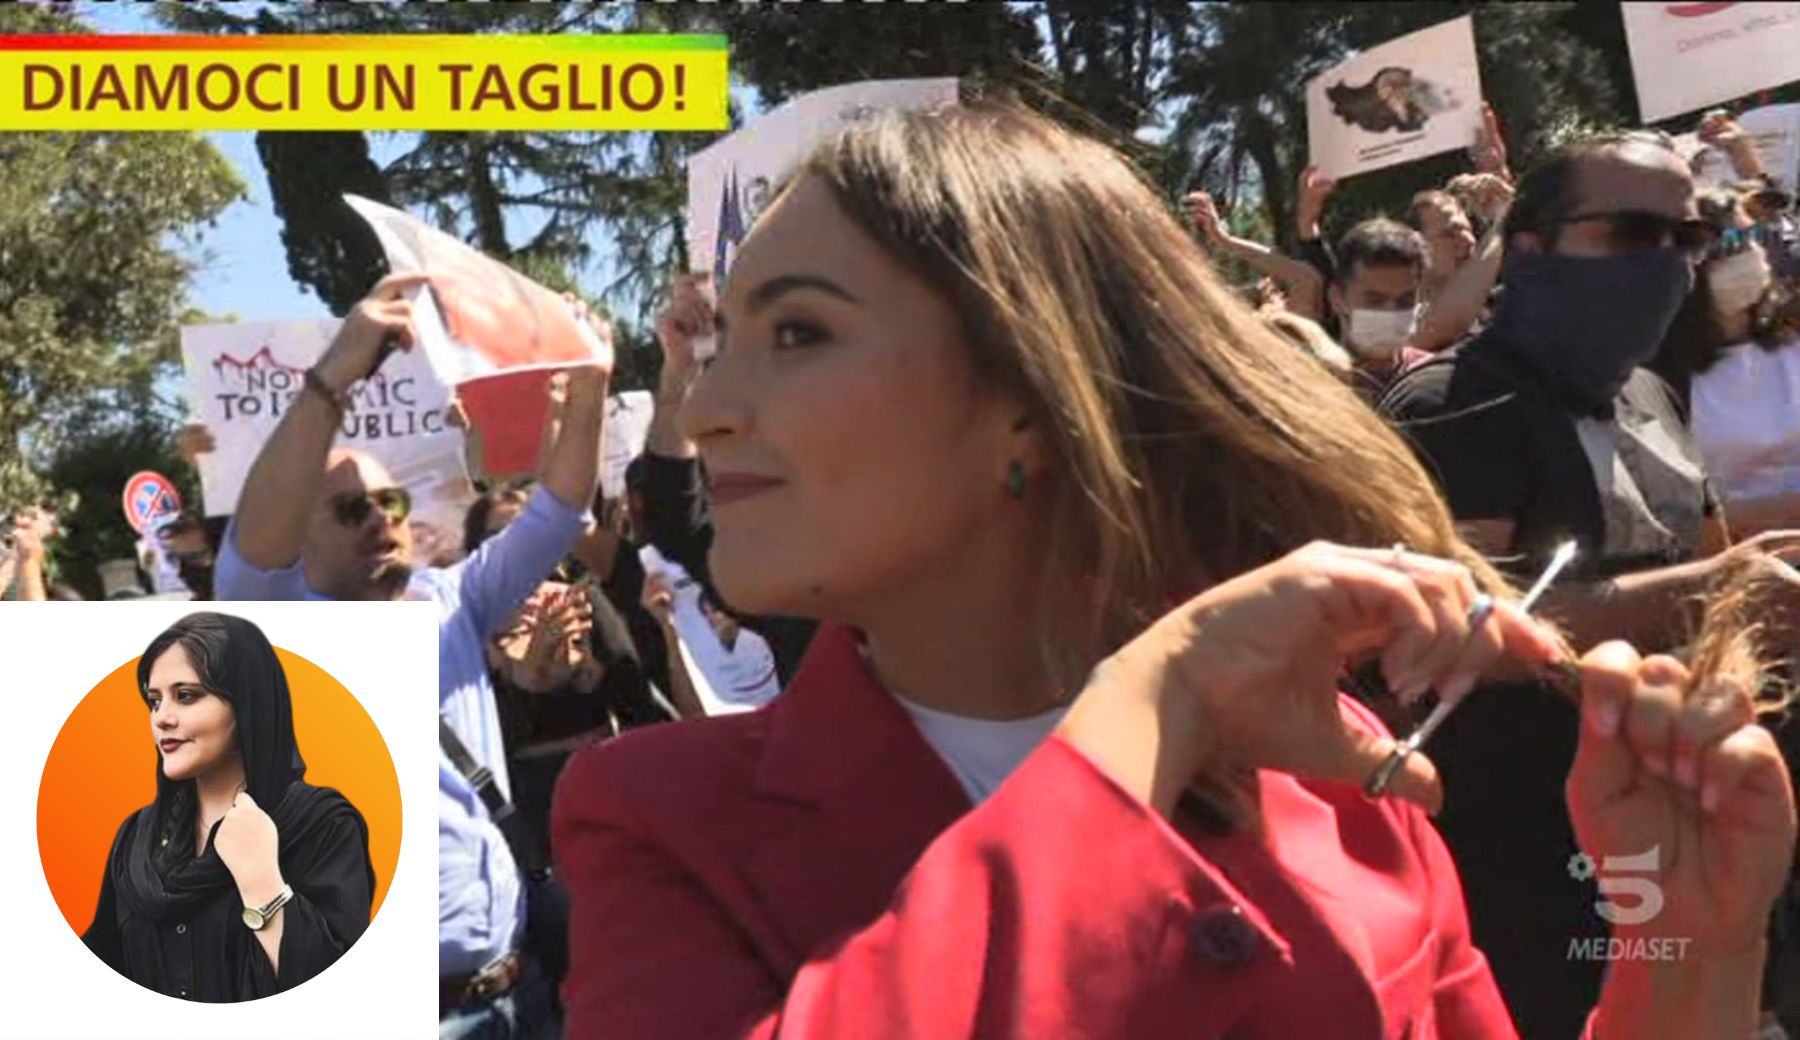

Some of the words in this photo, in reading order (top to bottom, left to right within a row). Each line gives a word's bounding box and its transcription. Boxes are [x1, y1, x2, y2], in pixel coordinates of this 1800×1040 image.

[248, 368, 291, 393] NO
[215, 393, 262, 420] TO
[343, 409, 444, 439] UBLIC
